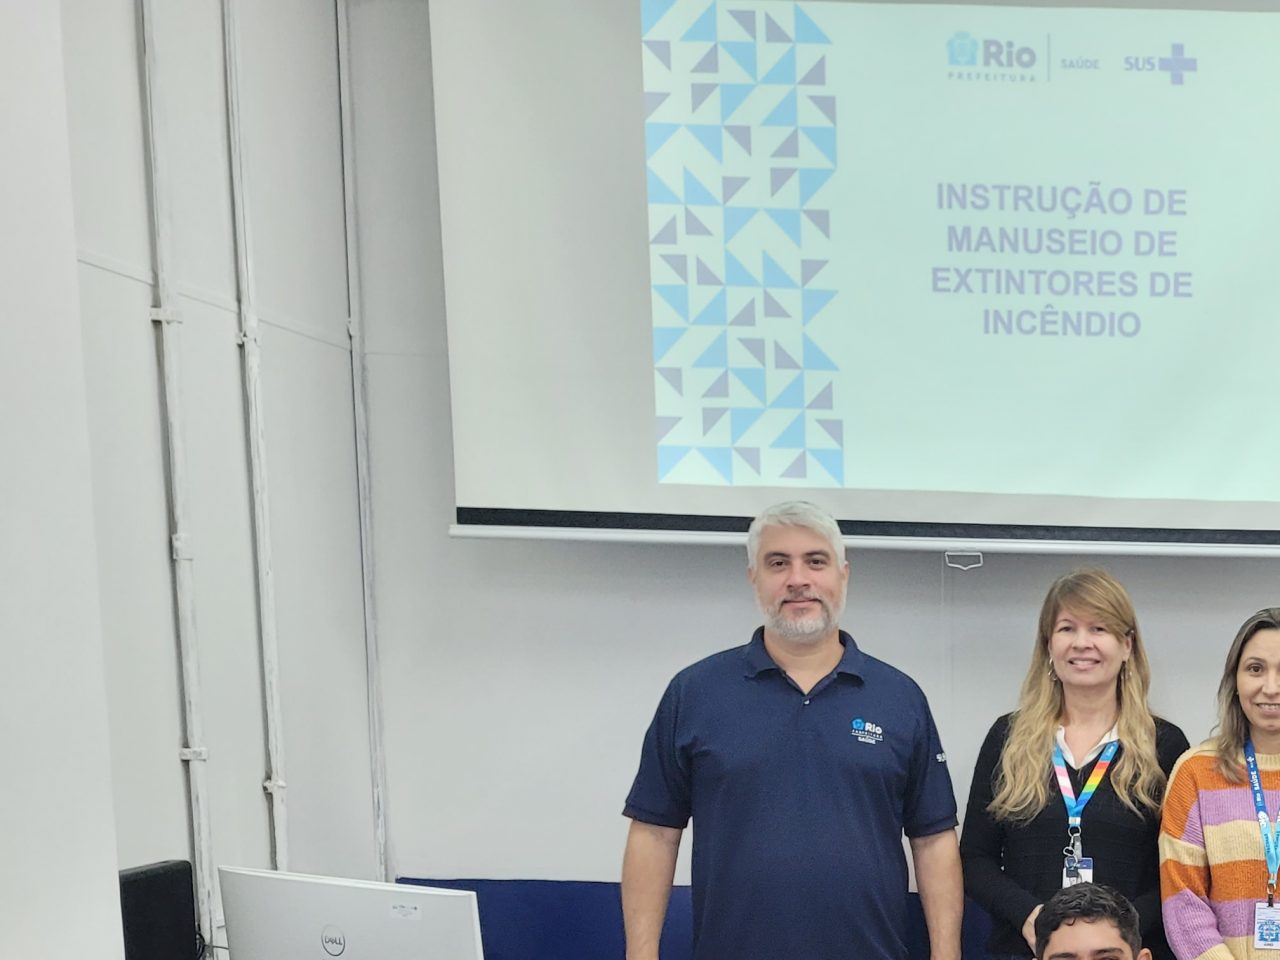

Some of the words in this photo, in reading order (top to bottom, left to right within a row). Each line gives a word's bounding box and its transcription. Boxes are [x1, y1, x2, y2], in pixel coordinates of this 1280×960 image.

[982, 38, 1037, 69] Rio
[1060, 56, 1100, 71] SAÚDE
[1123, 56, 1156, 72] SUS
[947, 71, 1037, 83] PREFEITURA
[935, 181, 1134, 219] INSTRUÇÃO
[1143, 189, 1188, 216] DE
[946, 225, 1124, 257] MANUSEIO
[1133, 231, 1178, 257] DE
[931, 267, 1139, 298] EXTINTORES
[1149, 271, 1193, 298] DE
[983, 304, 1142, 338] INCÊNDIO
[864, 722, 883, 735] Rio
